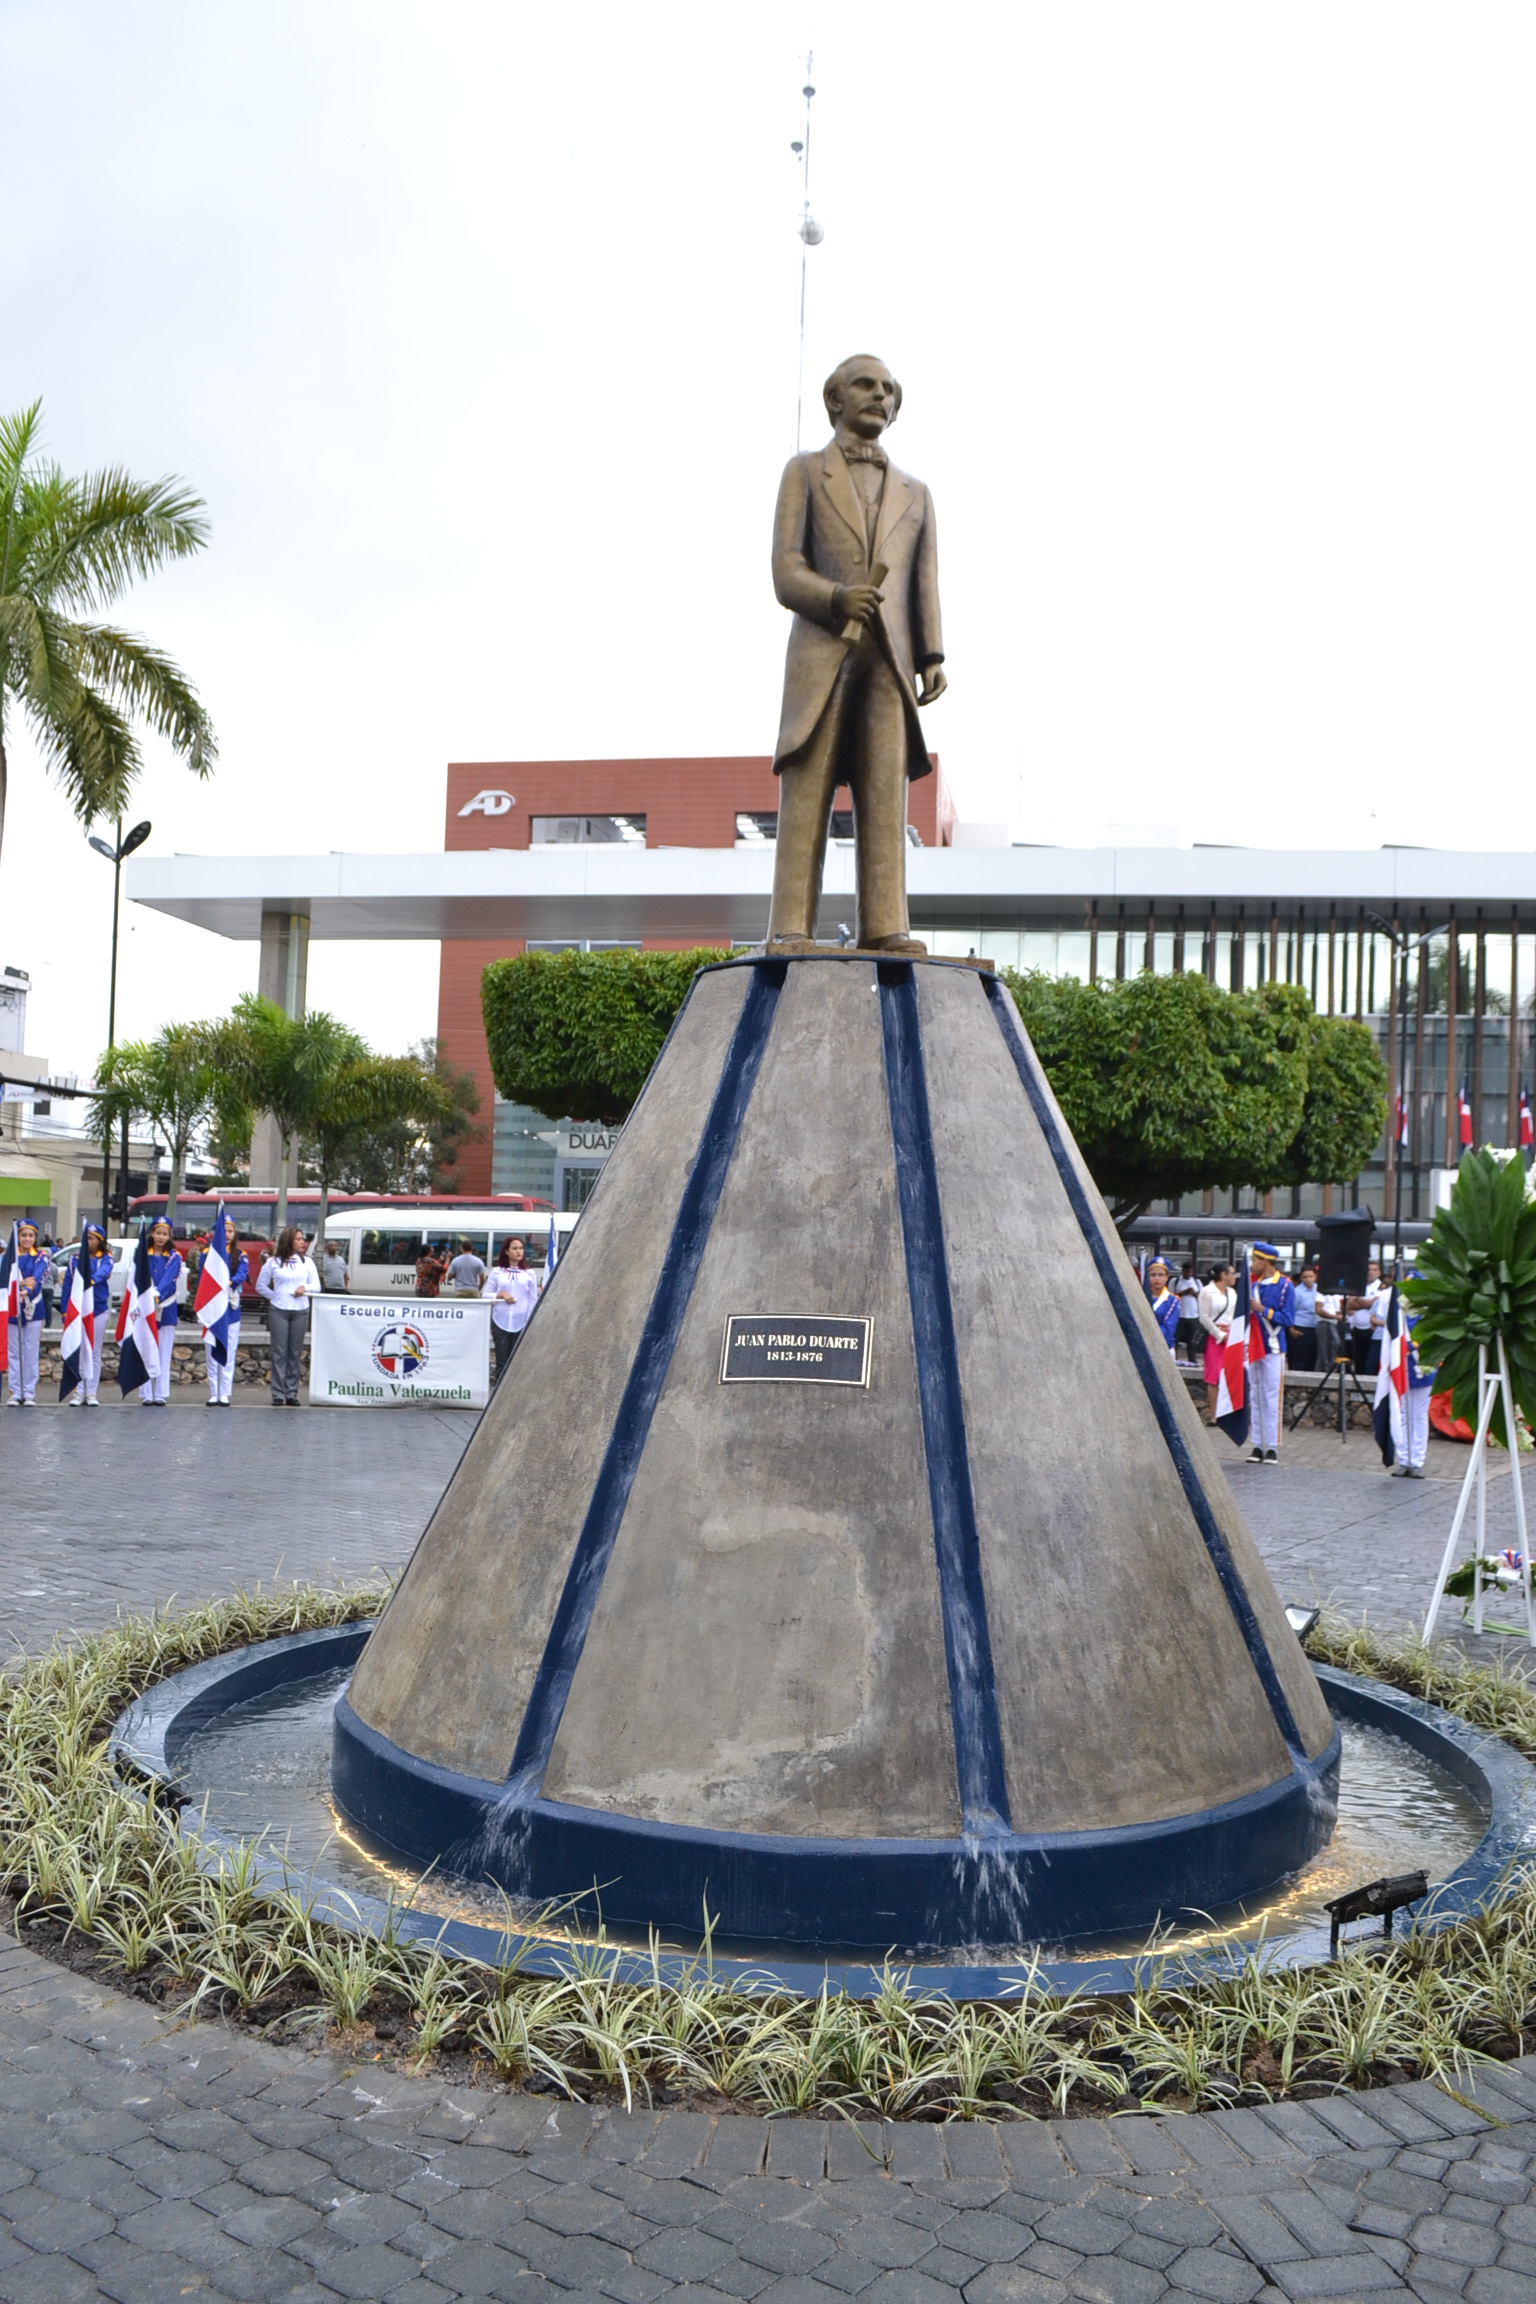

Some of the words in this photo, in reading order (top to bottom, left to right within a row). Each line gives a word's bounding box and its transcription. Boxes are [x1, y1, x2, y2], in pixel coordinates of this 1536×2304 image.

[340, 1304, 395, 1317] Escuela
[402, 1307, 464, 1319] Primaria
[735, 1335, 765, 1347] JUAN
[768, 1334, 806, 1347] PABLO
[809, 1335, 858, 1350] DUARTE
[766, 1351, 823, 1362] 1813-1876
[371, 1353, 400, 1380] FUNDADA
[327, 1380, 384, 1397] Paulina
[389, 1383, 471, 1400] Valenzuela
